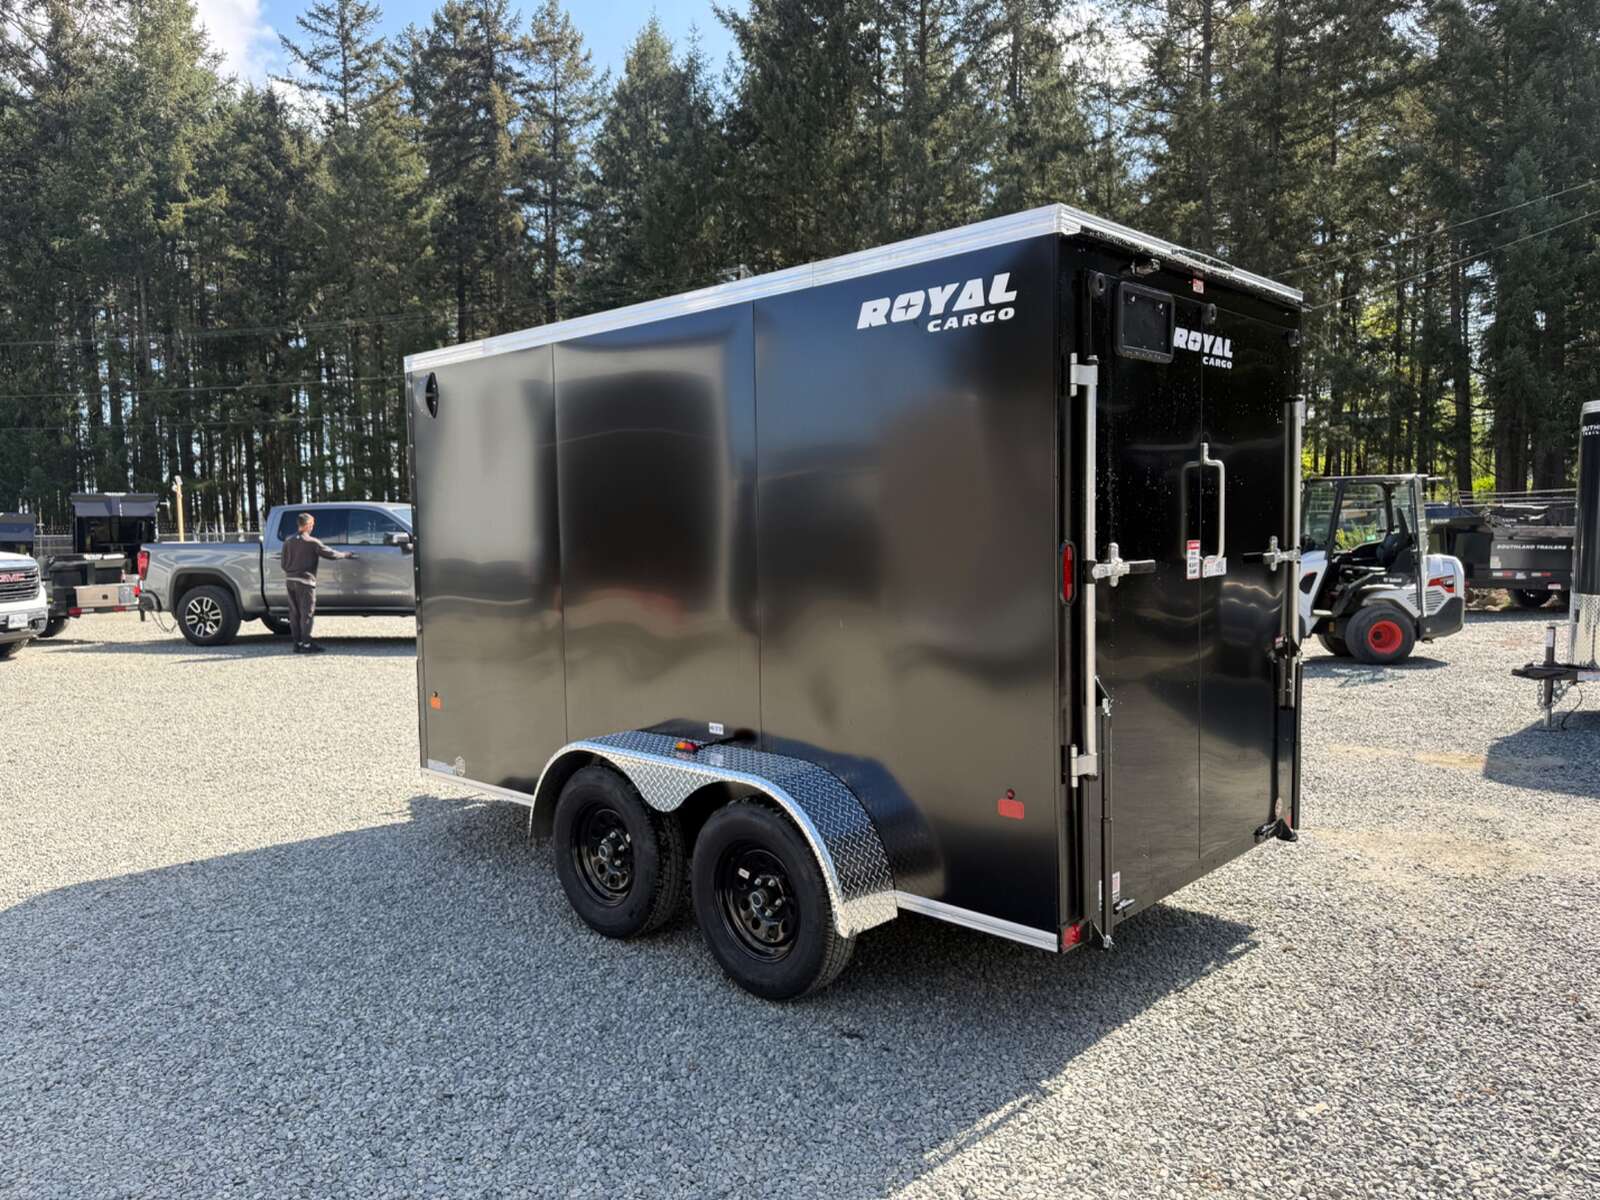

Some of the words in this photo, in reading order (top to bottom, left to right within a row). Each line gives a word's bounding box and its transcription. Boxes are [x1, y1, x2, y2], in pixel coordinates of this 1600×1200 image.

[857, 272, 1017, 330] ROYAL
[927, 307, 1015, 333] CARGO
[1173, 327, 1233, 359] ROYAL
[1202, 356, 1233, 370] CARGO
